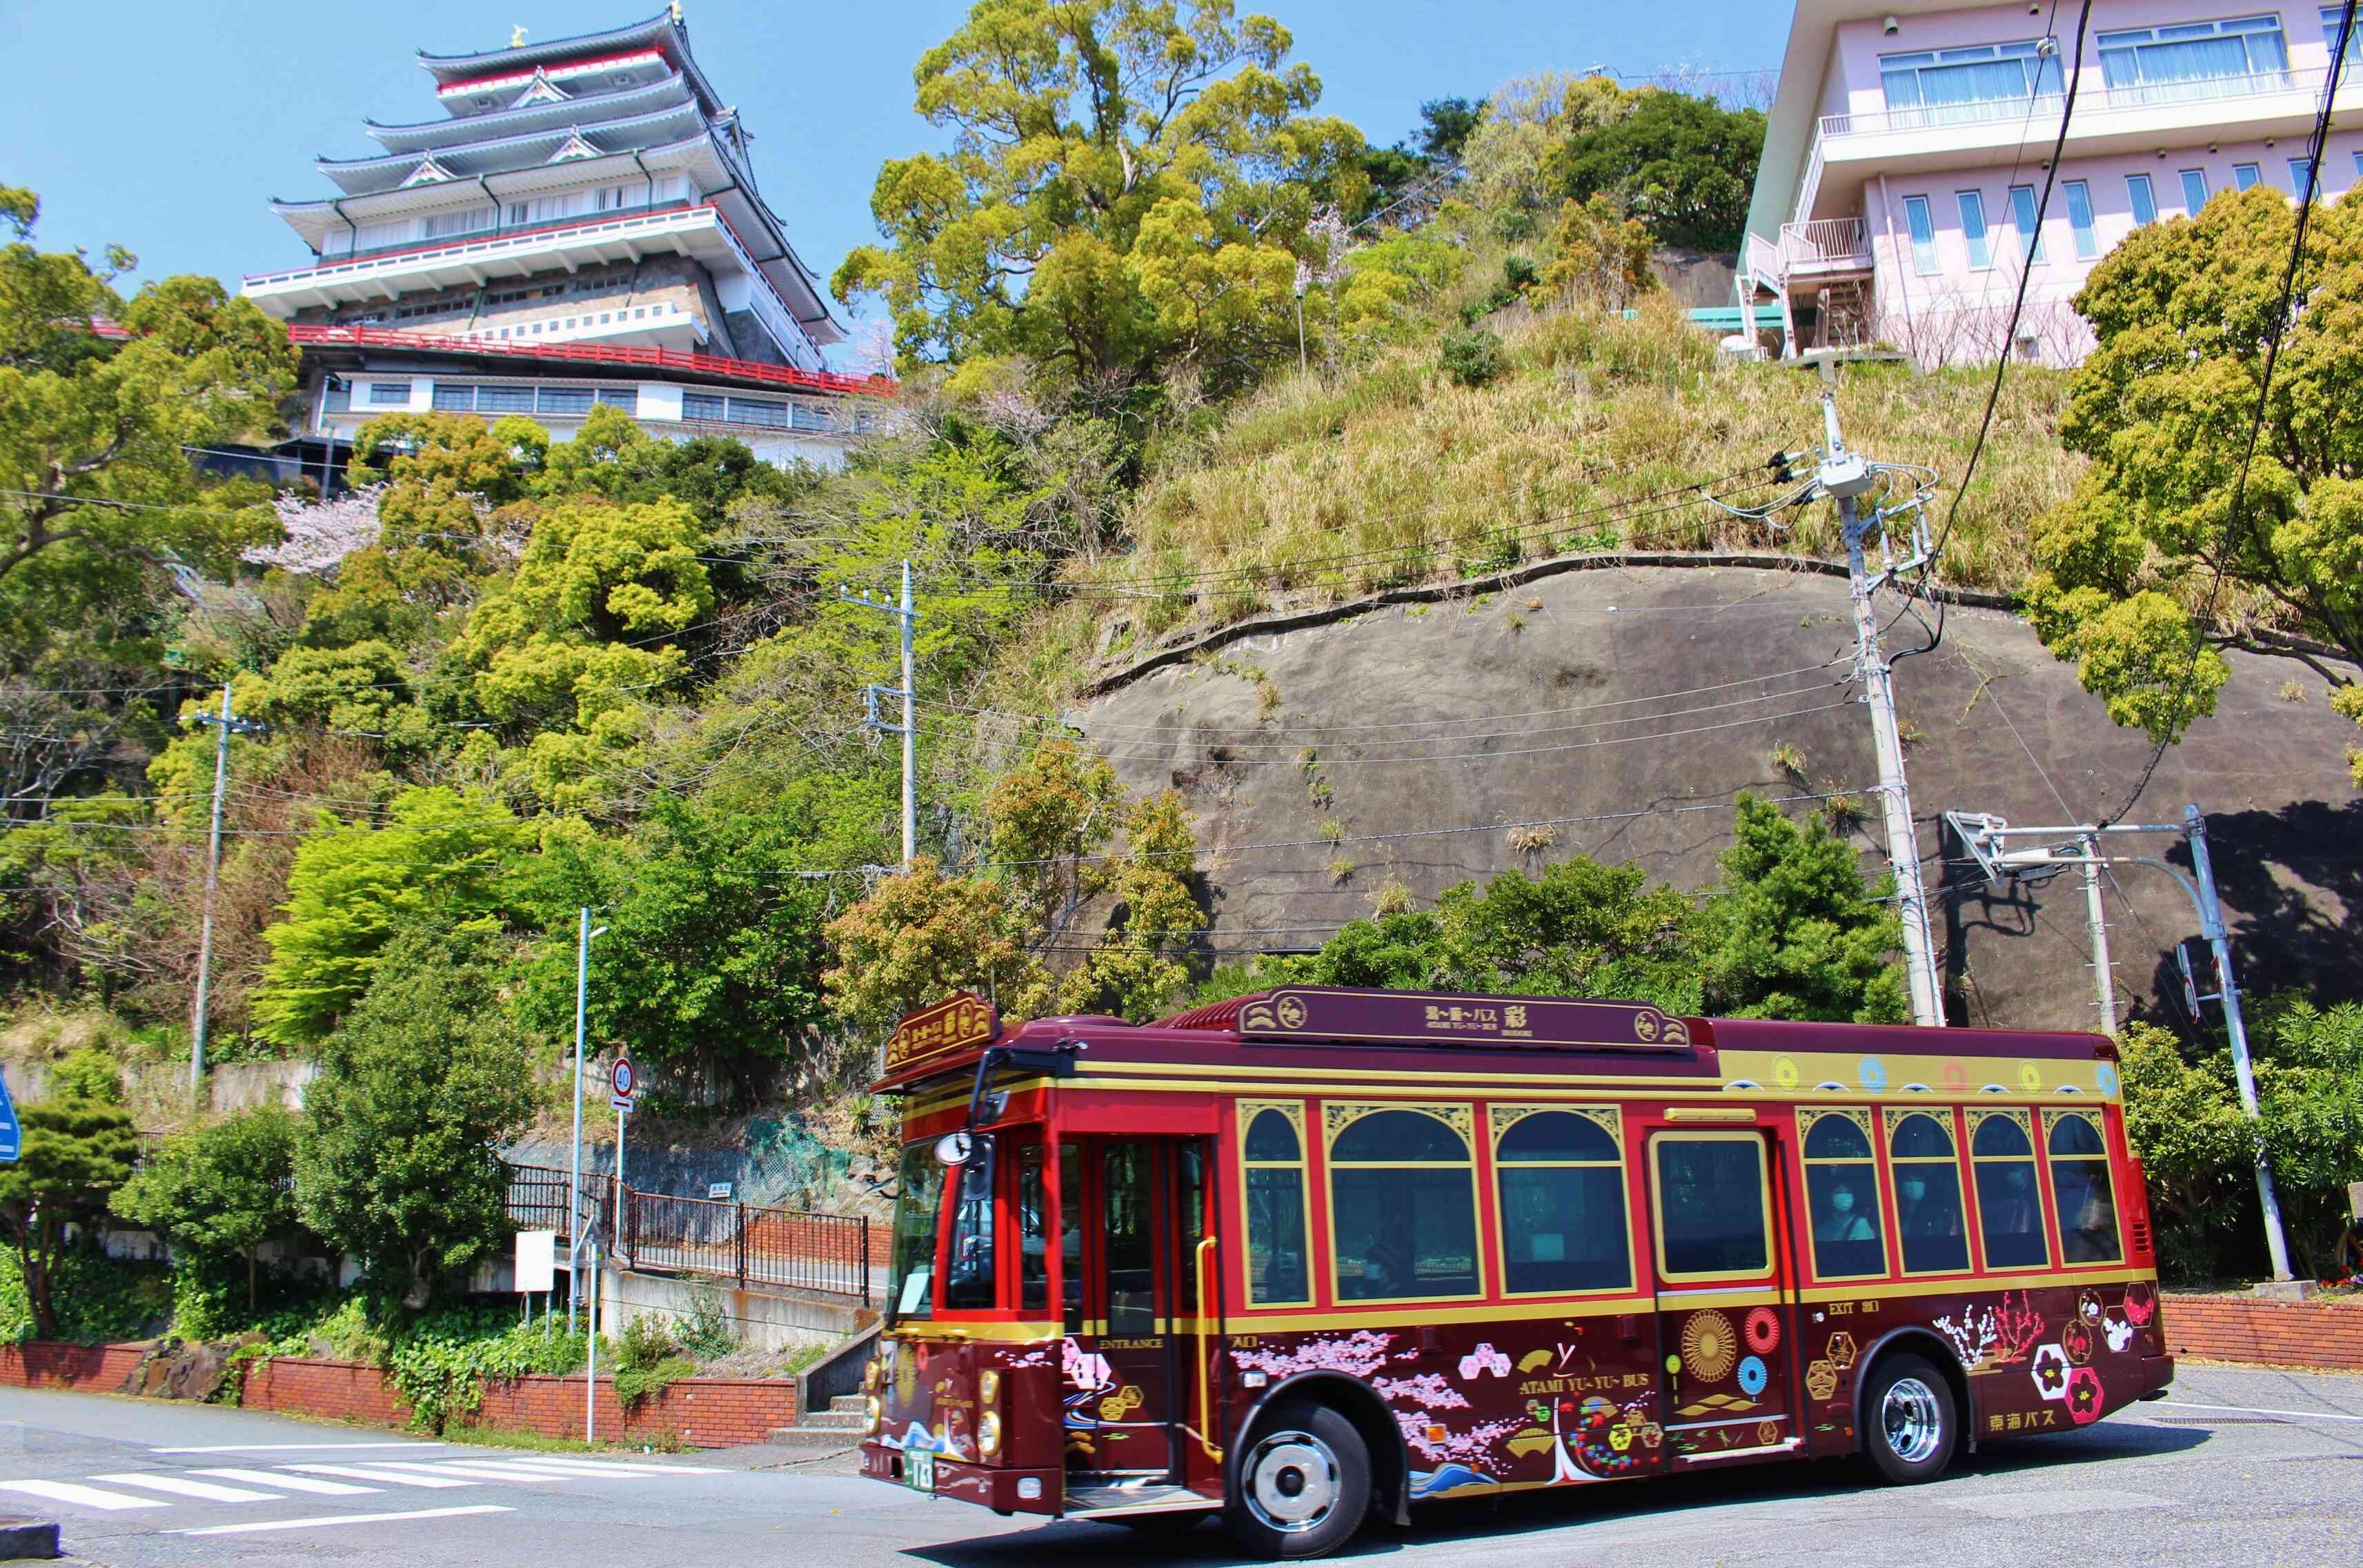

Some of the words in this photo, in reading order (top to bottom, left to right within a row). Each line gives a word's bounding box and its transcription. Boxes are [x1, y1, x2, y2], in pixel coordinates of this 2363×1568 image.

[617, 1070, 629, 1087] 40
[1829, 1302, 1854, 1315] EXIT
[1098, 1339, 1164, 1349] ENTRANCE
[1519, 1380, 1563, 1395] ATAMI
[1623, 1373, 1650, 1387] BUS
[1989, 1409, 2055, 1432] 東海バス
